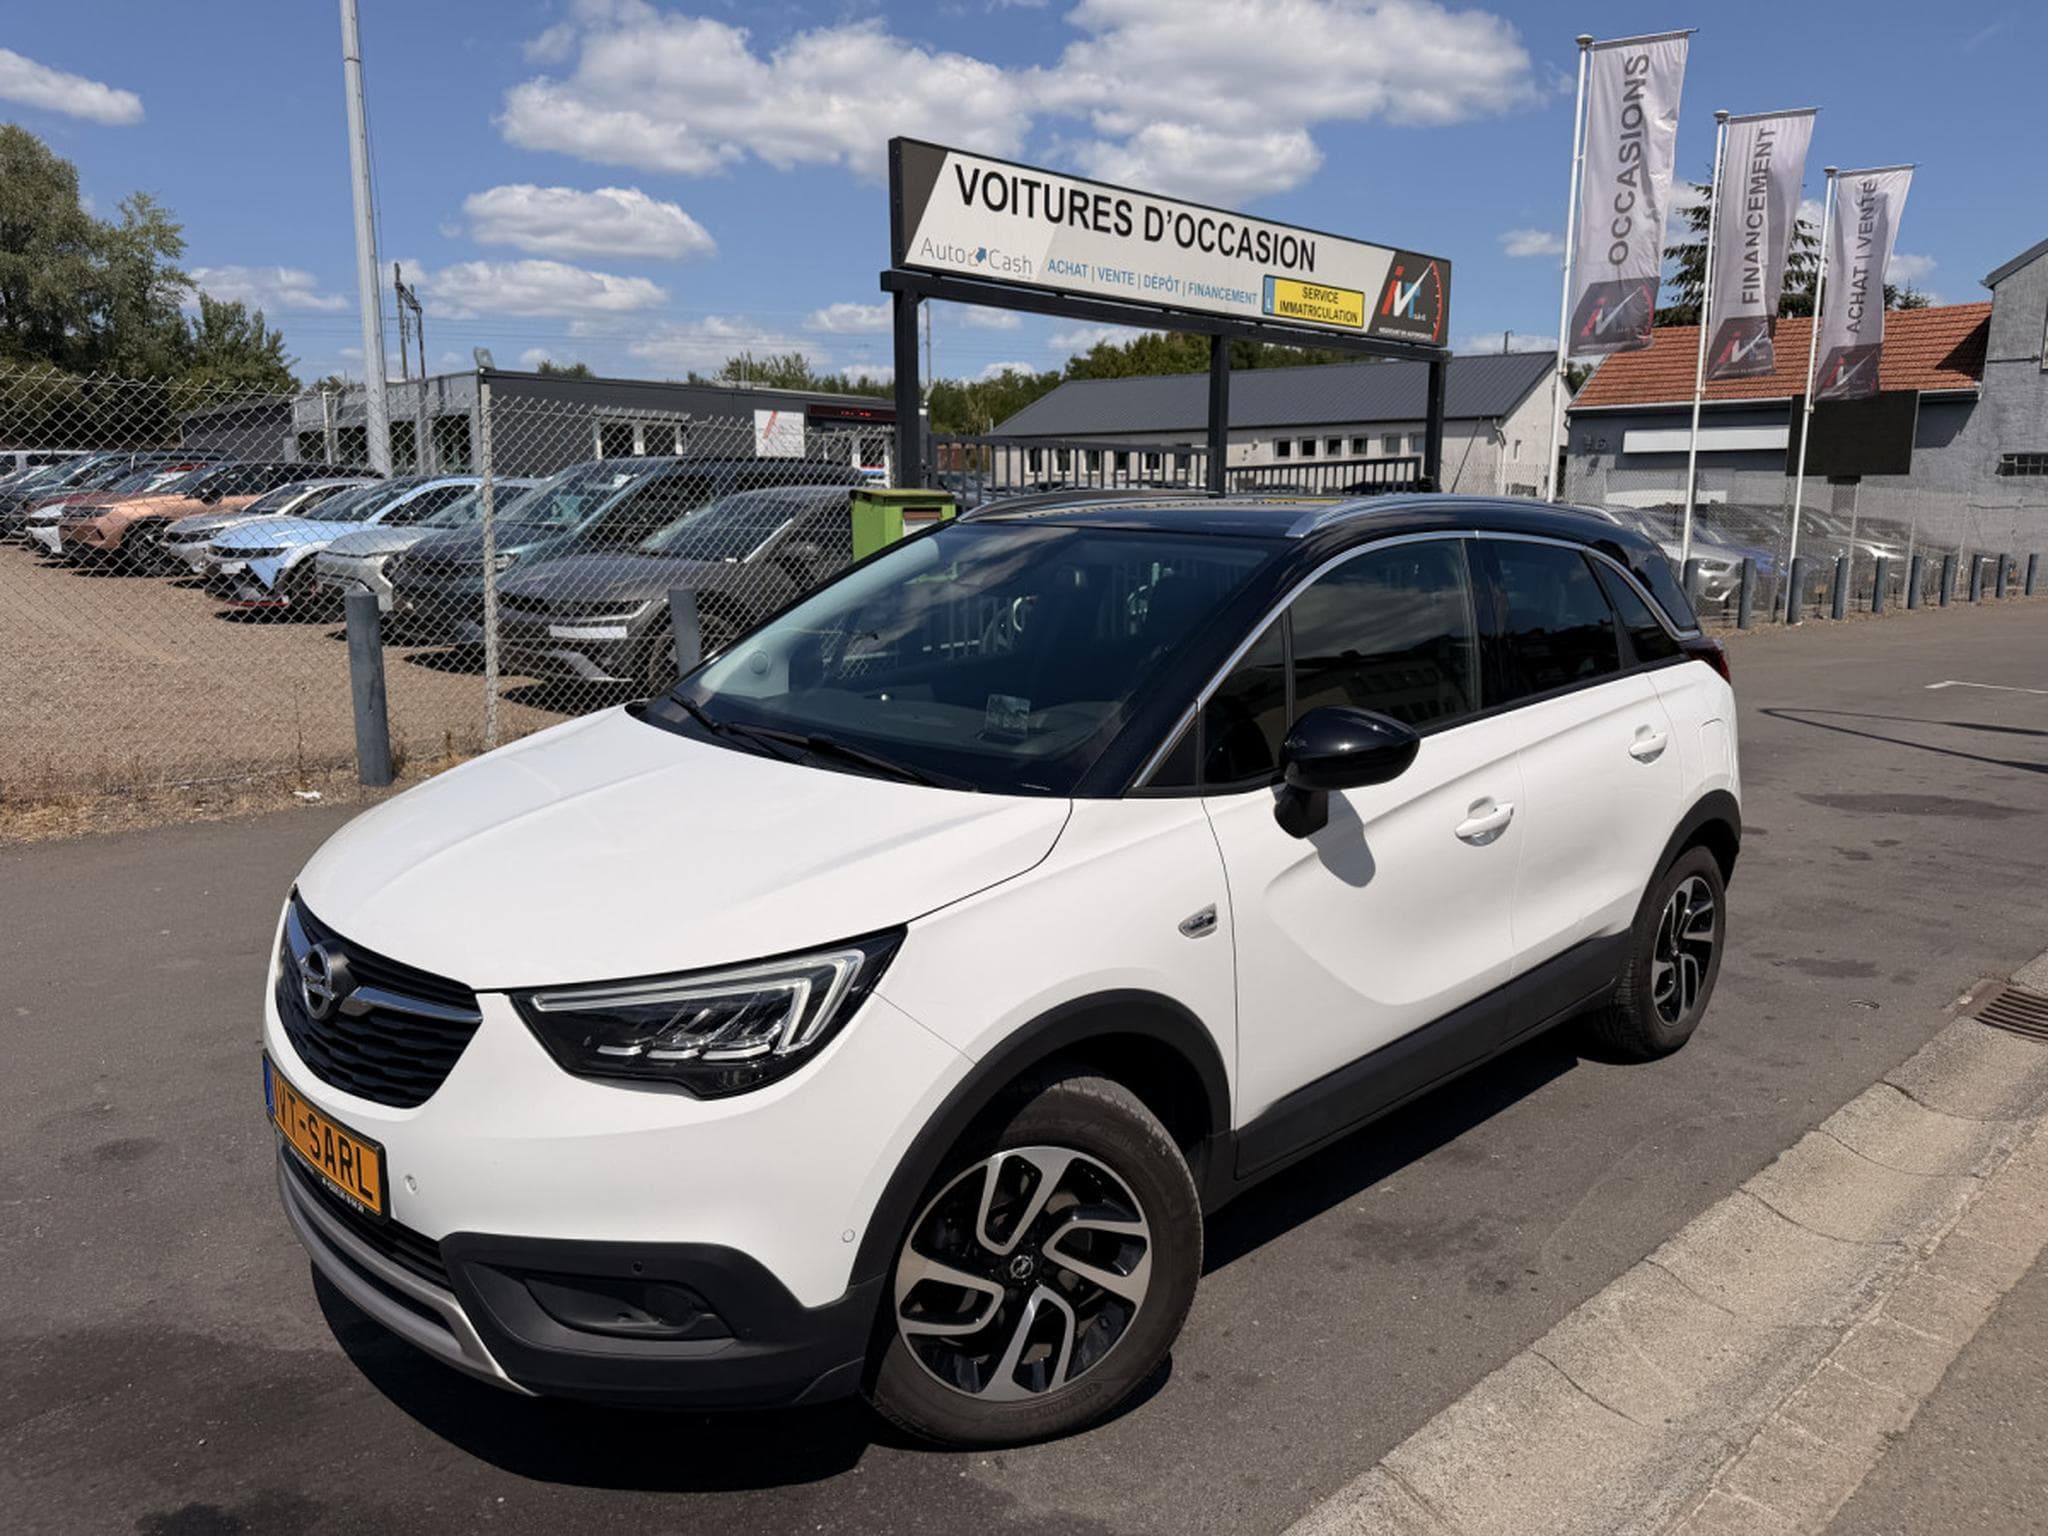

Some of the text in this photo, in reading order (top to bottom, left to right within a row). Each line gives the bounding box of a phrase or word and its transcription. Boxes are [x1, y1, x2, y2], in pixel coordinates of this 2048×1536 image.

[1608, 54, 1650, 265] OCCASIONS
[955, 164, 1316, 273] VOITURES D'OCCASION
[1741, 128, 1776, 304] FINANCEMENT
[920, 237, 1033, 274] Auto Cash
[1047, 259, 1088, 278] ACHAT
[1097, 267, 1136, 286] VENTE
[1188, 282, 1258, 304] FINANCEMENT
[1846, 180, 1878, 334] ACHAT VENTE
[1279, 300, 1358, 323] IMMATRICULATION
[1302, 286, 1339, 304] SERVICE
